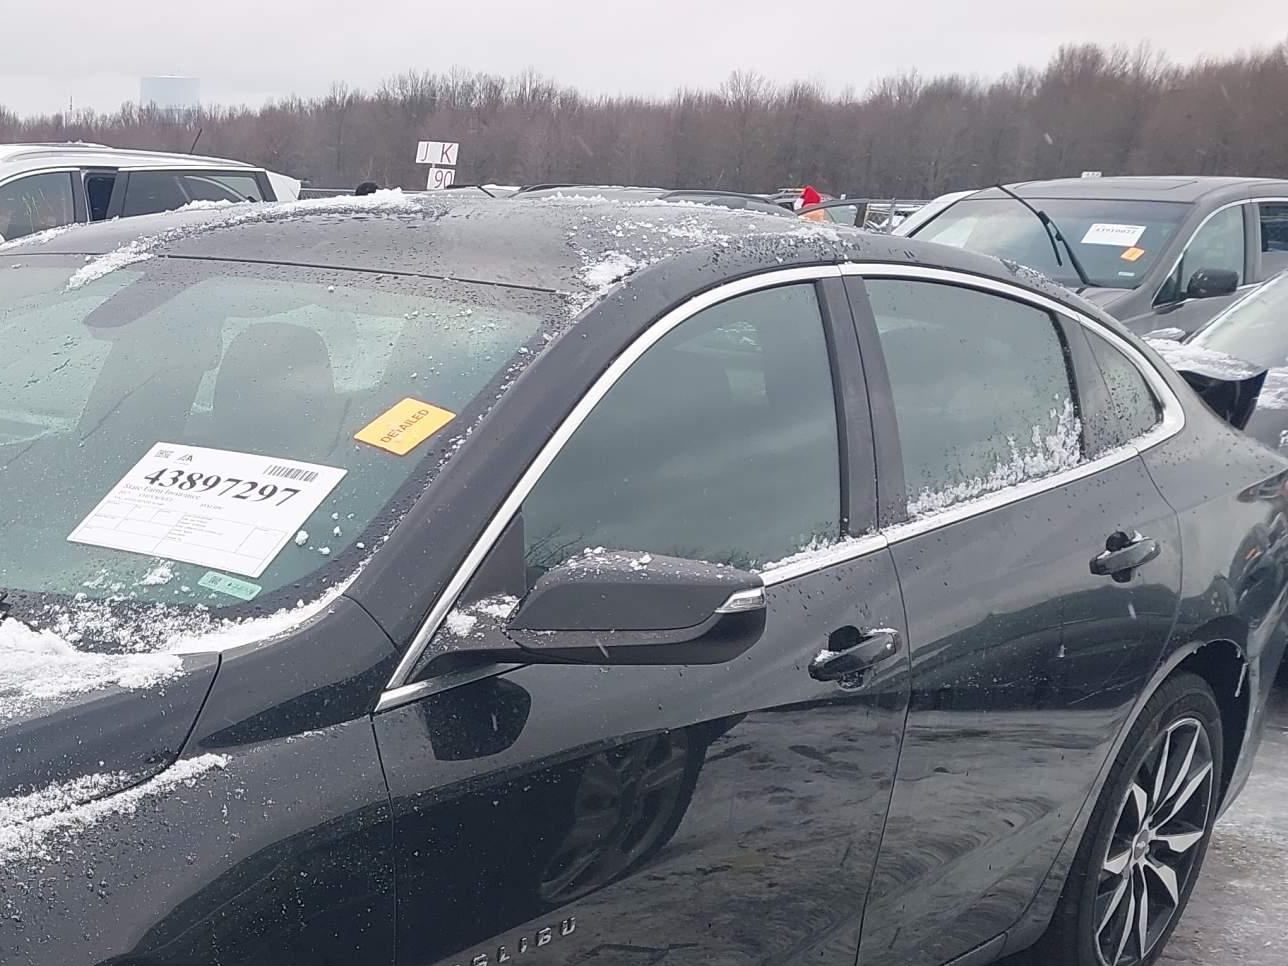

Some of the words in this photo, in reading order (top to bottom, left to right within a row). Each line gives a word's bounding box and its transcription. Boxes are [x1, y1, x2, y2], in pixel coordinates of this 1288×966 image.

[421, 143, 430, 161] J
[440, 143, 453, 163] K
[434, 170, 453, 188] 90
[380, 409, 430, 443] DETAILED
[144, 468, 302, 507] 43897297
